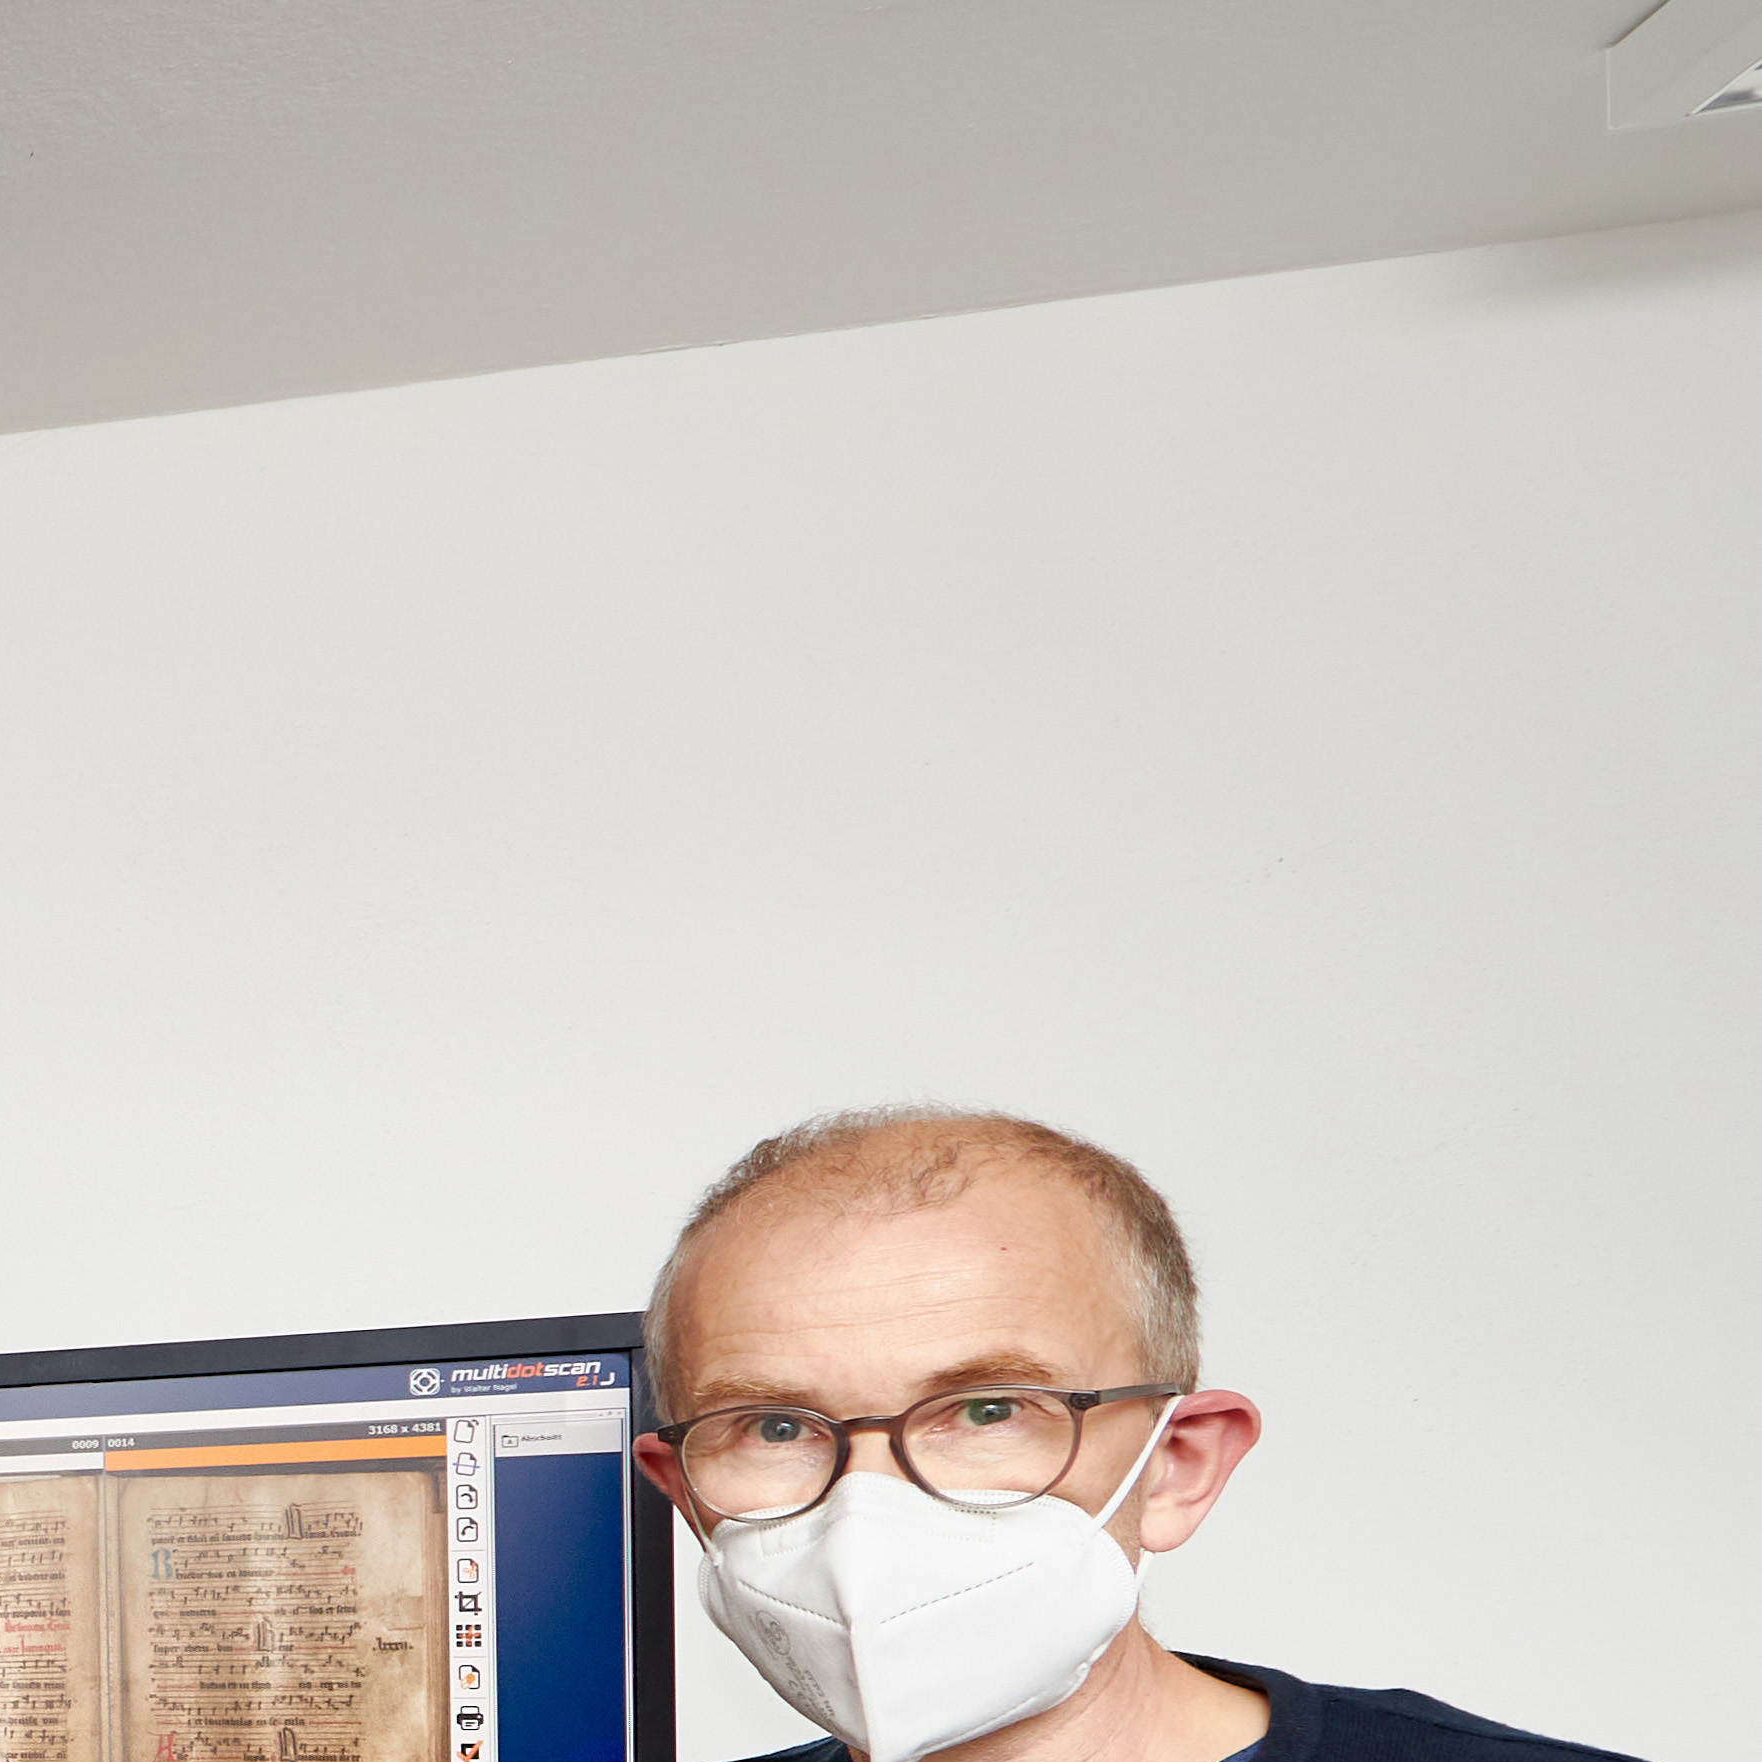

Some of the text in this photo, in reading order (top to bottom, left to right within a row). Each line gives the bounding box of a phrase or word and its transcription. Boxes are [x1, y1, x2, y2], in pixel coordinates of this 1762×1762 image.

[451, 1361, 601, 1382] multidotscan
[576, 1375, 598, 1387] 2.1
[368, 1424, 398, 1435] 3168
[412, 1422, 442, 1433] 4381
[108, 1438, 135, 1448] 0014
